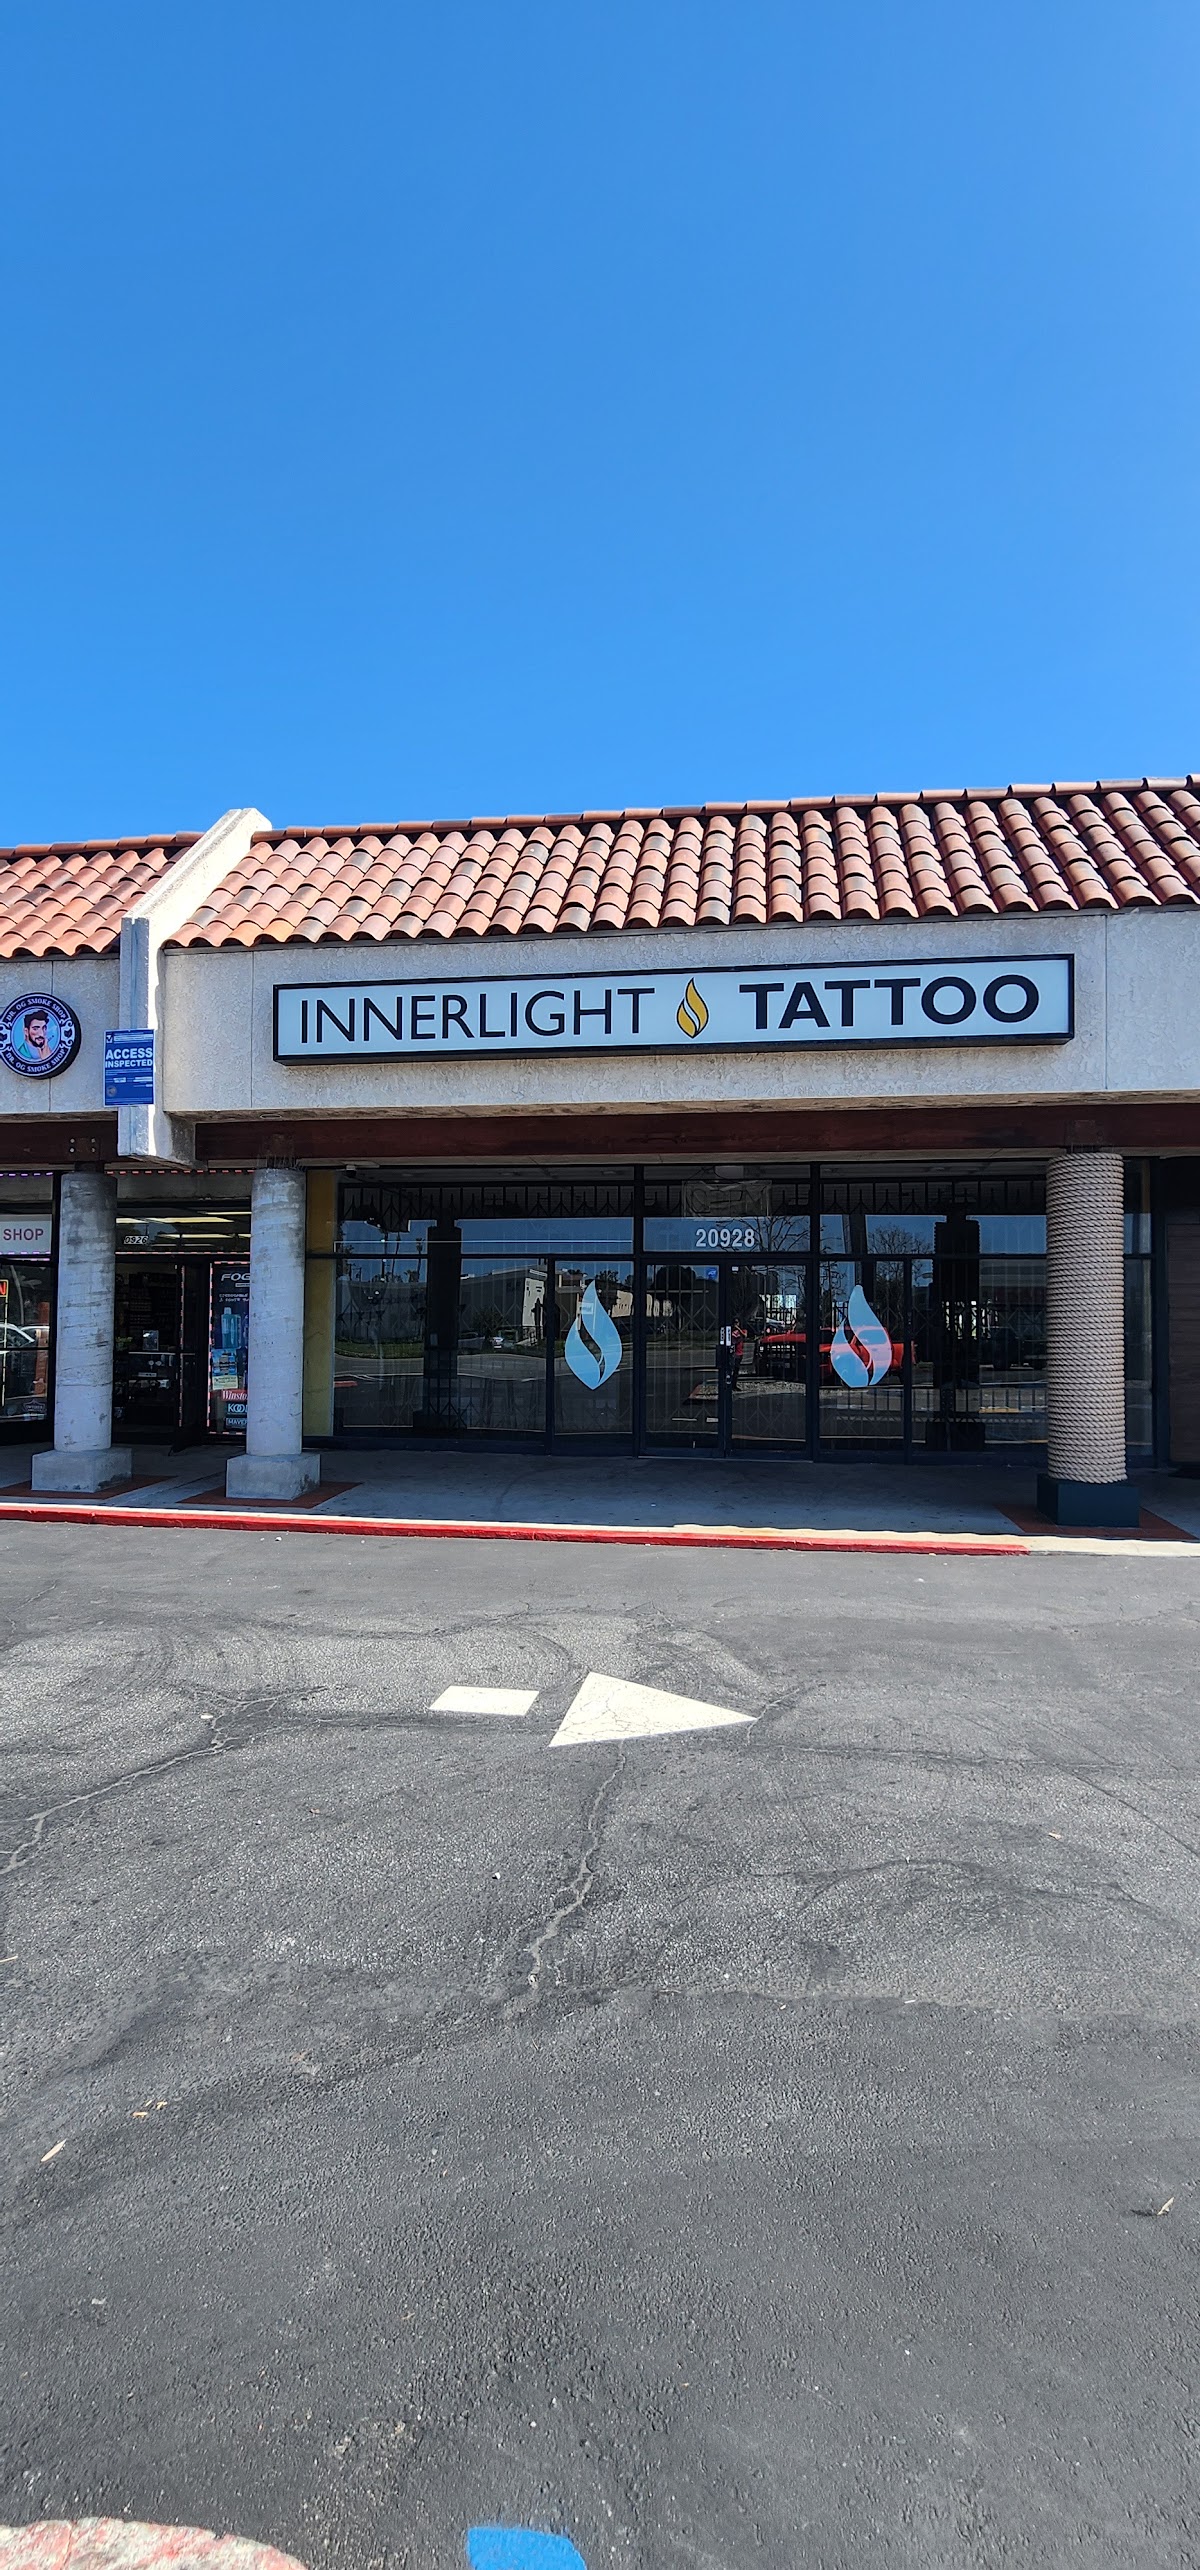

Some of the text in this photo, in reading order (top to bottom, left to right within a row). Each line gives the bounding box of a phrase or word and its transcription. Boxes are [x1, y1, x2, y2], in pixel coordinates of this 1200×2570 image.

[16, 1001, 26, 1010] OG
[27, 998, 52, 1006] SMOKE
[52, 1004, 66, 1018] SHOP
[300, 974, 1039, 1044] INNERLIGHT TATTOO
[16, 1062, 25, 1070] OG
[27, 1063, 51, 1072] SMOKE
[51, 1049, 65, 1065] SHOP
[106, 1047, 153, 1060] ACCESS
[105, 1059, 153, 1068] INSPECTED
[3, 1228, 44, 1241] SHOP
[695, 1228, 755, 1247] 20928
[222, 1390, 248, 1400] Winsto
